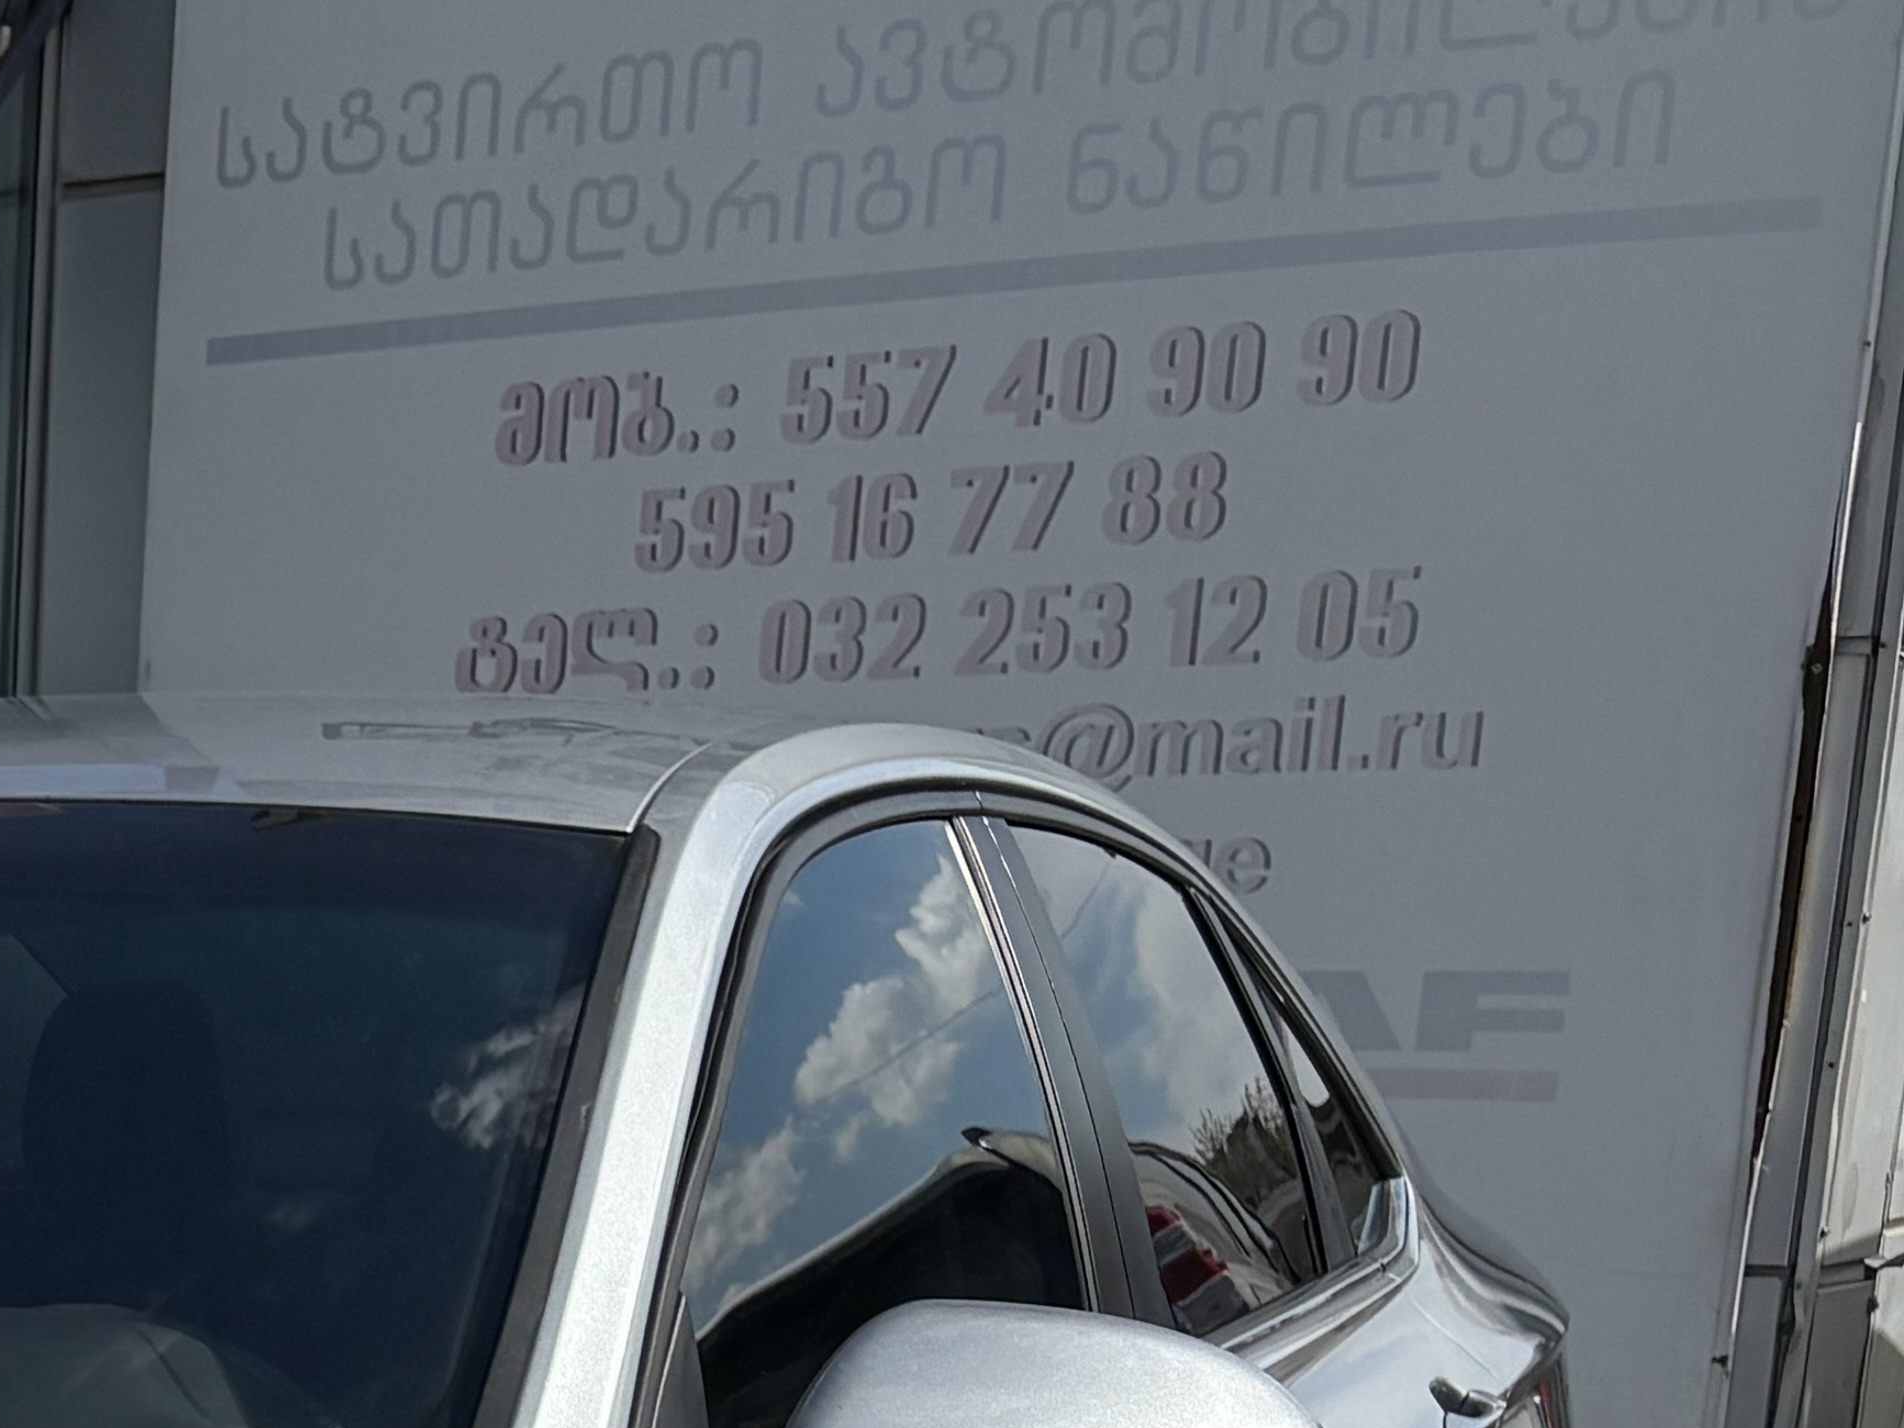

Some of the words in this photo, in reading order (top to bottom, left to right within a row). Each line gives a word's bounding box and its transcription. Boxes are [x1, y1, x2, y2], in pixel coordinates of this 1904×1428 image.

[216, 38, 764, 188] სატვირთო
[814, 0, 1847, 118] ავტომობილ
[323, 133, 1007, 290] სათადარიგო
[1064, 68, 1677, 215] ნაწილები
[780, 344, 958, 445] 557
[983, 333, 1118, 427] 40
[1145, 320, 1267, 418] 90
[1297, 309, 1422, 407] 90
[634, 479, 795, 572] 595
[827, 472, 919, 562] 16
[947, 460, 1075, 555] 77
[1100, 450, 1229, 546] 88
[758, 593, 928, 684] 032
[952, 581, 1133, 676] 253
[1165, 574, 1269, 668] 12
[1296, 565, 1424, 661] 05
